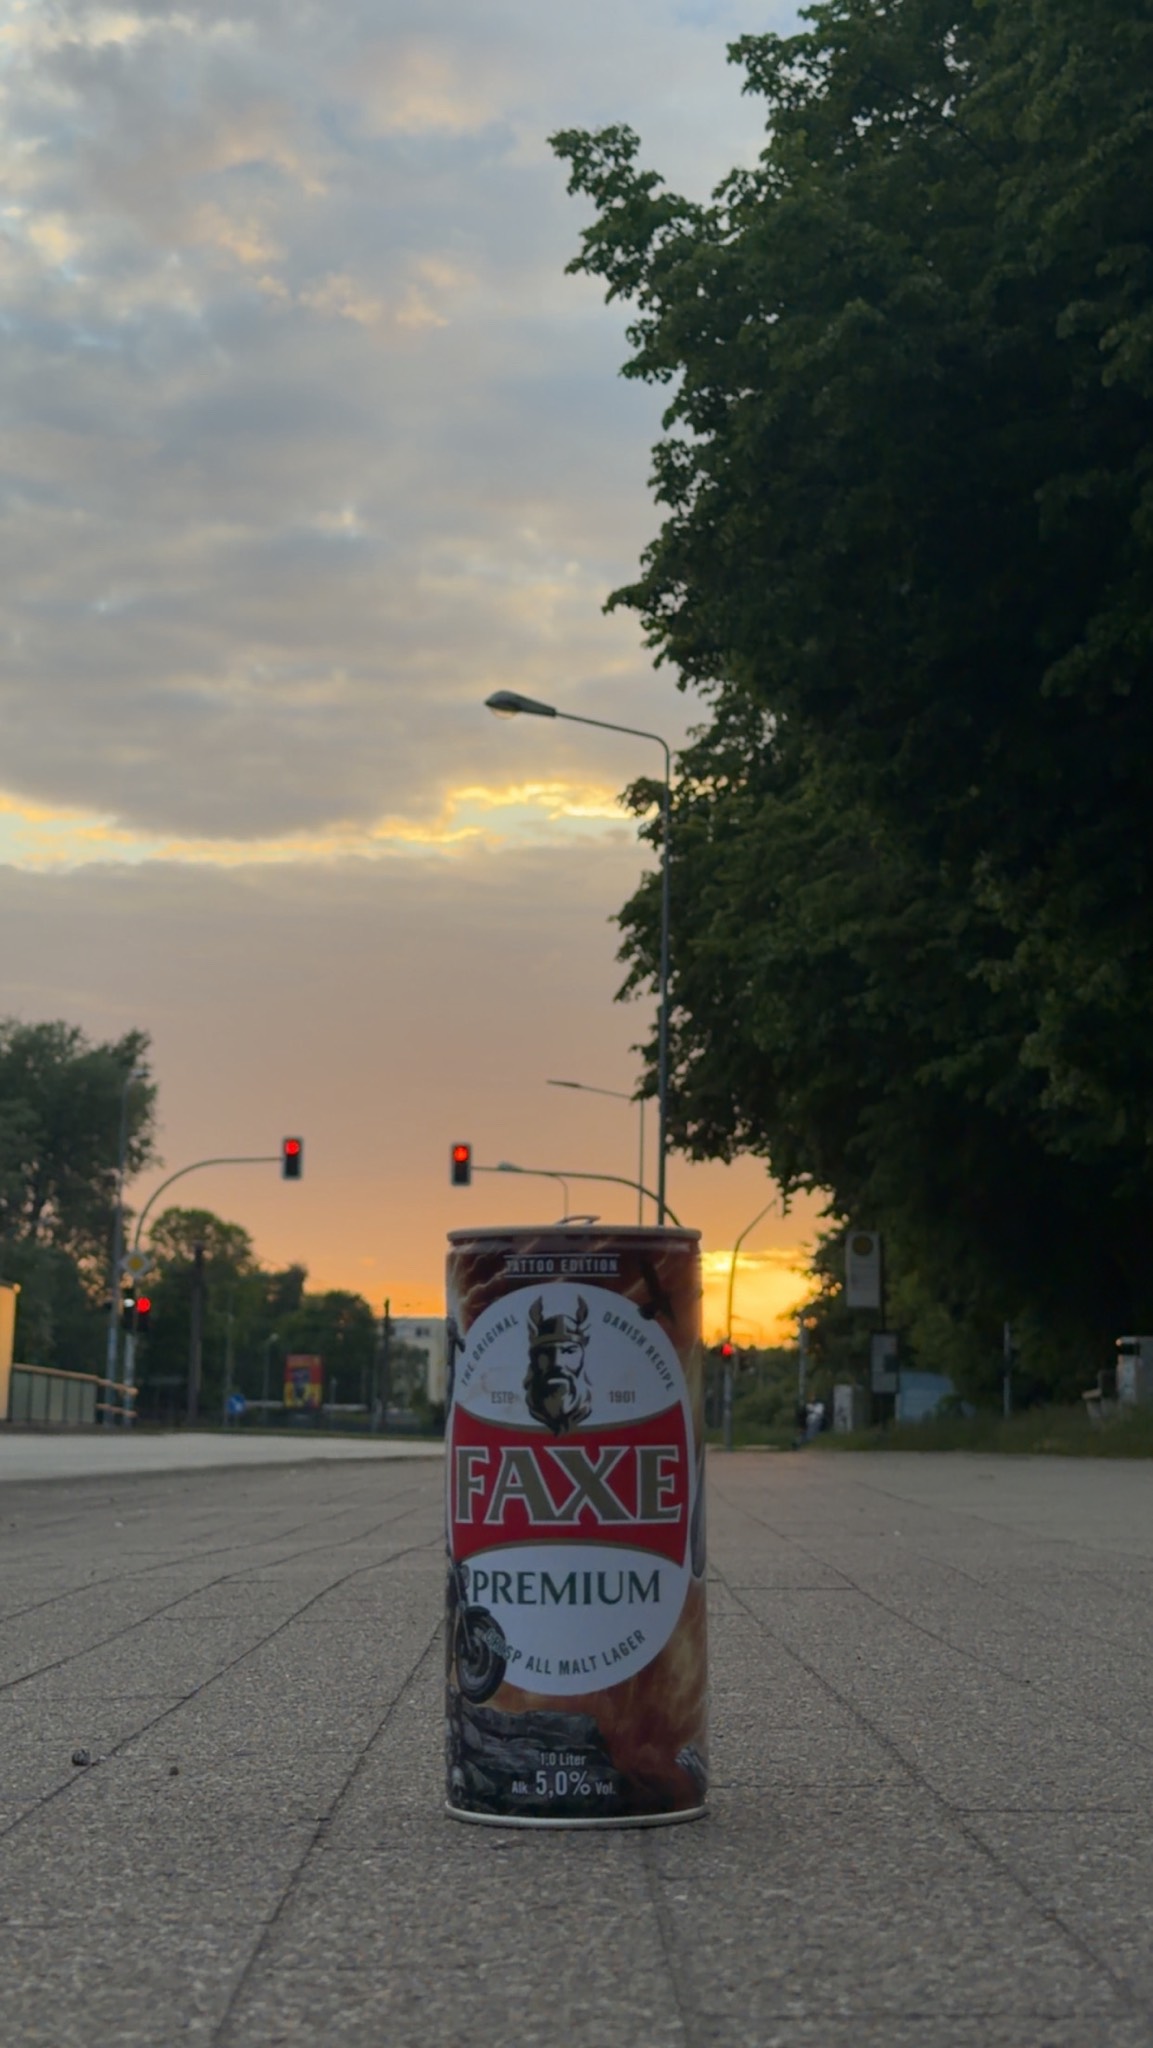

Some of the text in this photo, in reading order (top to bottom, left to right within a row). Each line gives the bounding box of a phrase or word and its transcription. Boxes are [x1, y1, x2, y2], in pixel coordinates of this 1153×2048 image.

[505, 1258, 618, 1272] TATTOO EDITION
[461, 1314, 519, 1386] THE ORIGINAL
[602, 1311, 676, 1391] DANISH RECIPE
[608, 1390, 636, 1404] 1901
[455, 1445, 682, 1525] FAXE
[472, 1569, 661, 1606] PREMIUM
[525, 1655, 552, 1675] ALL
[559, 1655, 598, 1676] MALT
[601, 1629, 646, 1666] LAGER
[559, 1752, 587, 1766] Liter
[535, 1770, 591, 1798] 5,0%
